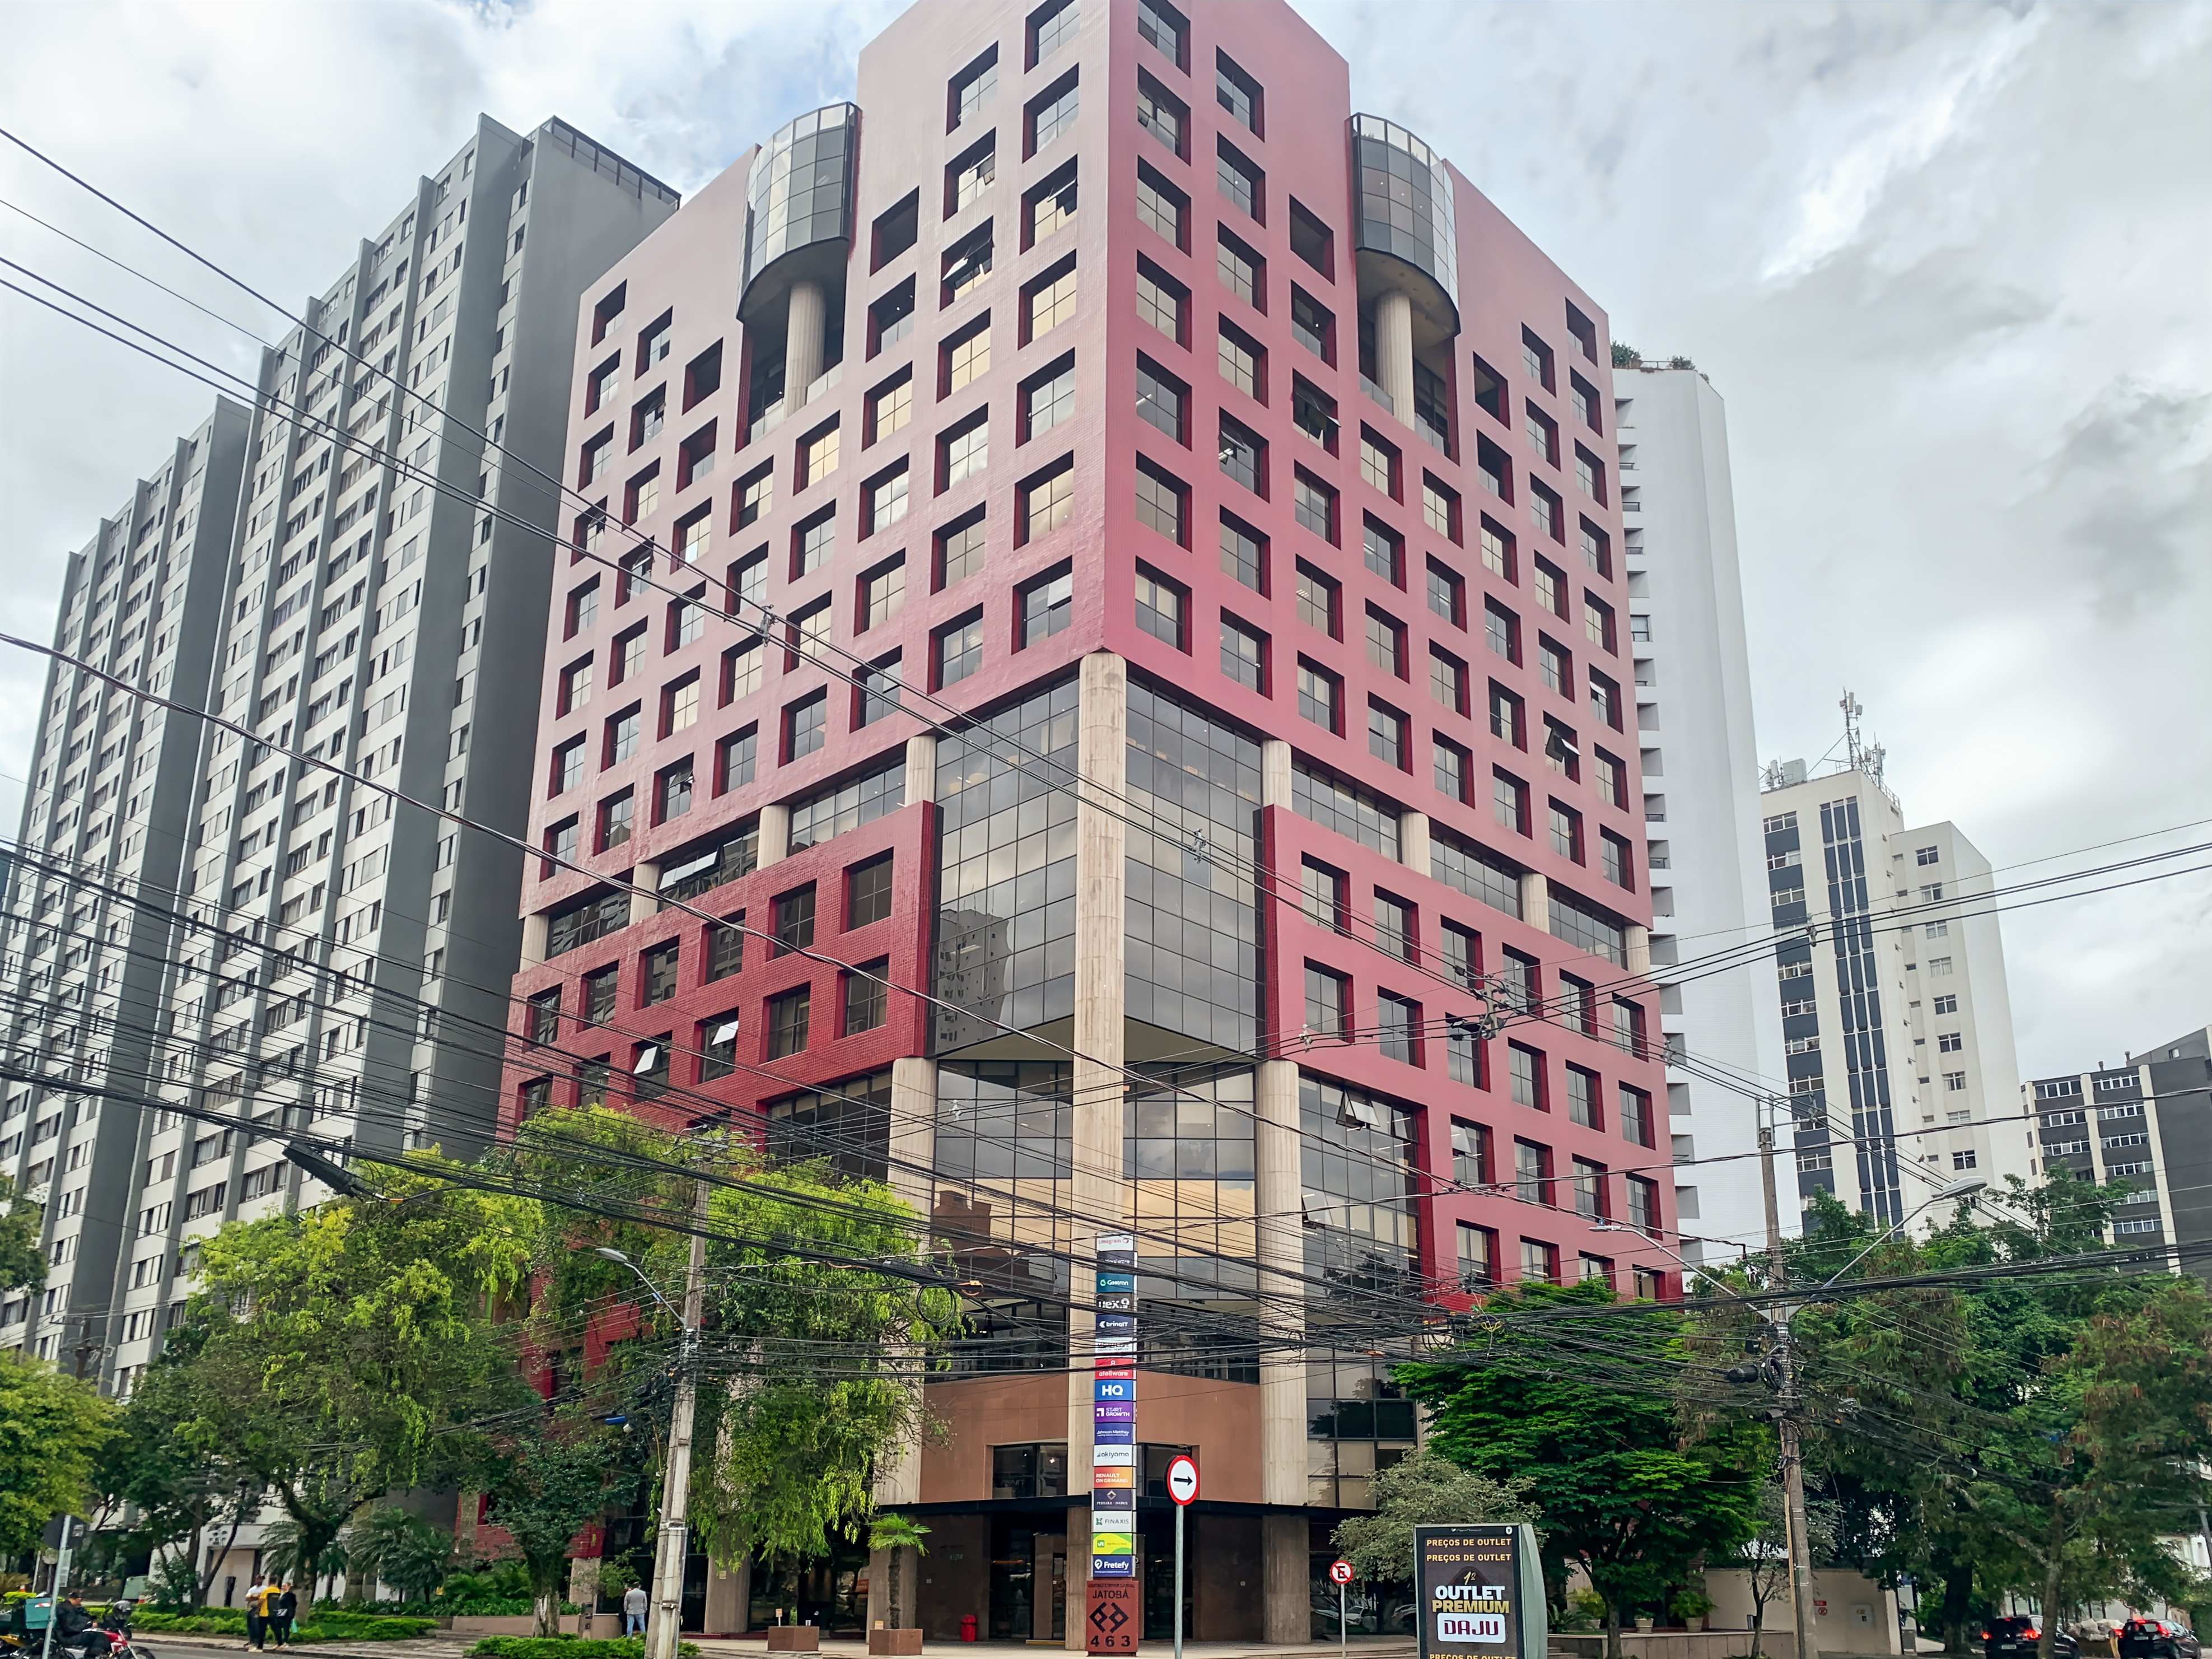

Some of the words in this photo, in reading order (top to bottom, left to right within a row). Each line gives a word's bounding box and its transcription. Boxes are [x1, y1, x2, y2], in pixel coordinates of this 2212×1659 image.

[1102, 1385, 1123, 1396] HQ
[1426, 1540, 1460, 1548] PREÇOS
[1426, 1554, 1460, 1563] PREÇOS
[1104, 1561, 1129, 1570] Fretefy
[1338, 1566, 1346, 1578] E
[1435, 1586, 1505, 1600] OUTLET
[1432, 1600, 1510, 1614] PREMIUM
[1444, 1620, 1499, 1635] DAJU
